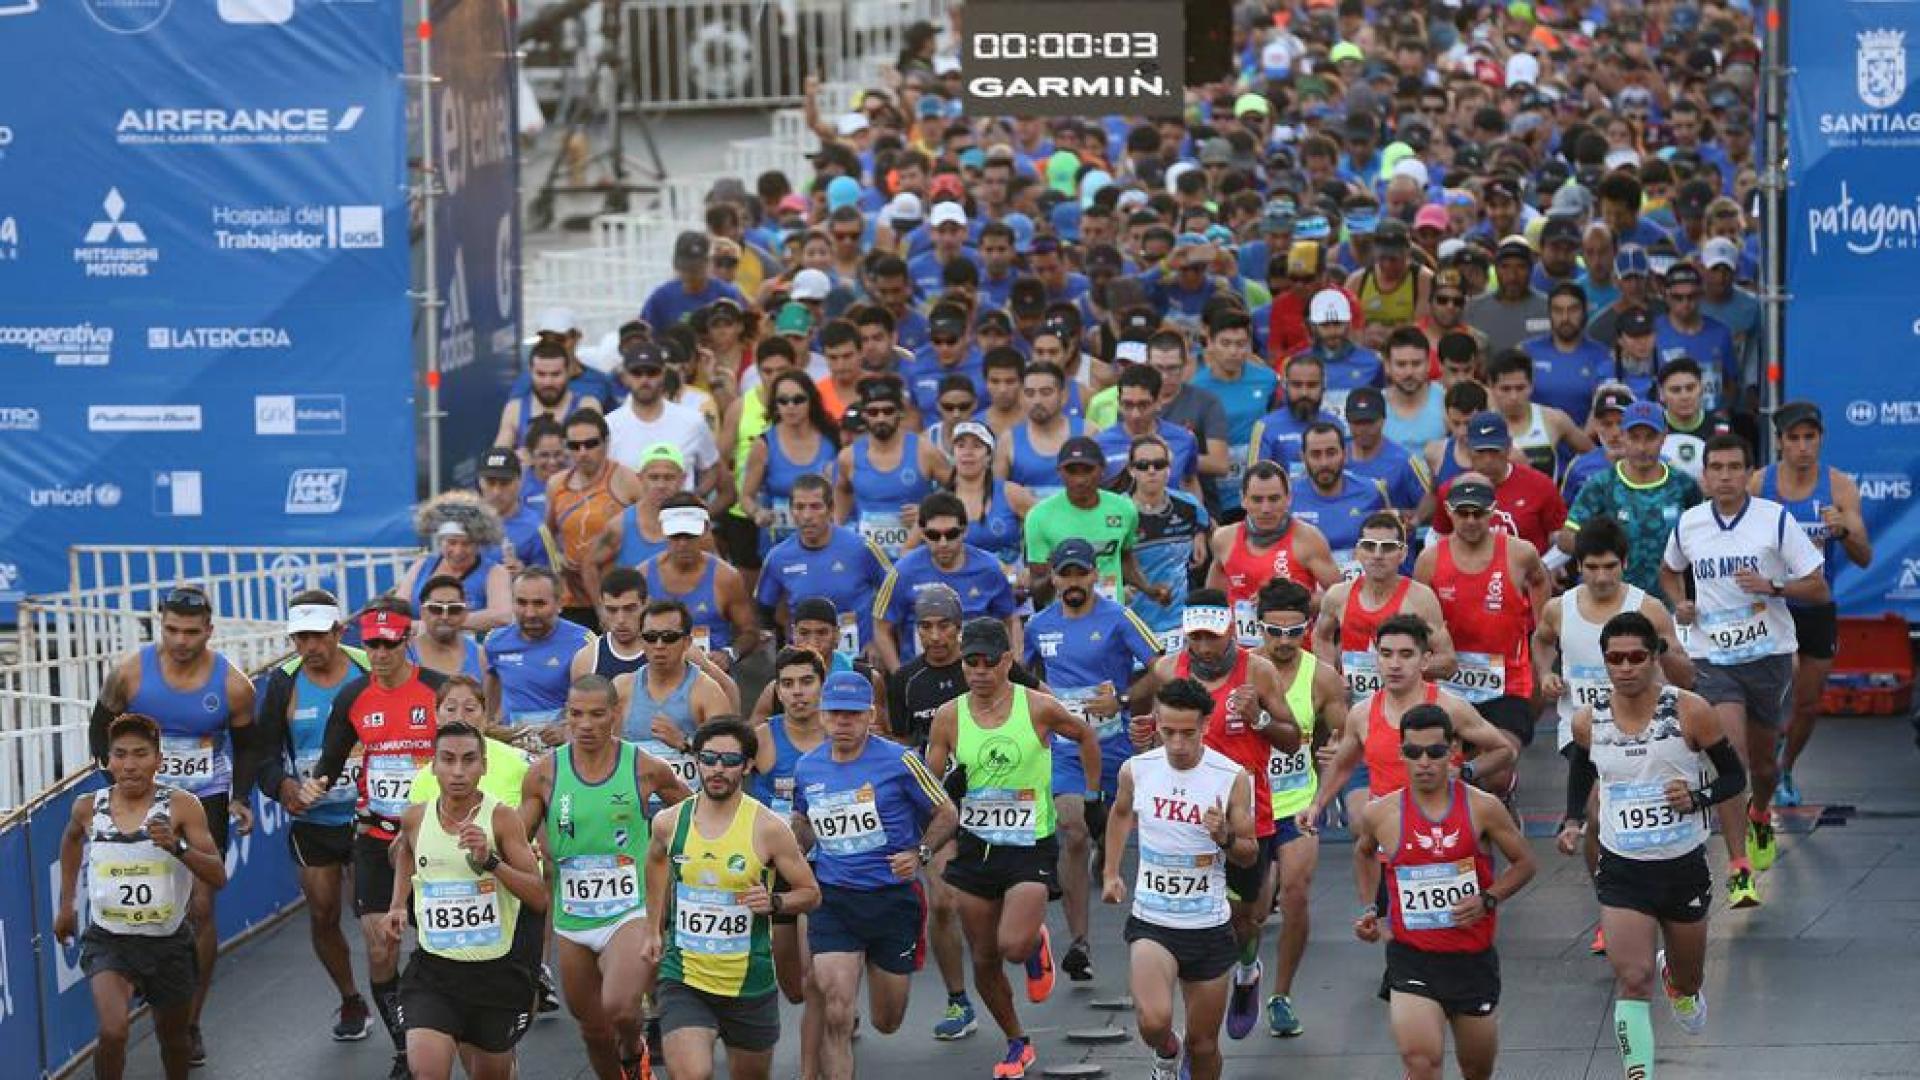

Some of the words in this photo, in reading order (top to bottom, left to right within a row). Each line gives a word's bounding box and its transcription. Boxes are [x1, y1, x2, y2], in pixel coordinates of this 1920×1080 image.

[973, 33, 1159, 59] 00:00:03
[968, 72, 1163, 97] GARMIN
[117, 109, 328, 131] AIRFRANCE
[213, 206, 290, 227] Hospital
[295, 205, 325, 224] del
[215, 230, 323, 251] Trabajador
[74, 247, 158, 262] MITSUBISHI
[86, 263, 148, 277] MOTORS
[31, 483, 92, 506] unicef
[1859, 480, 1911, 500] AIMS
[1695, 558, 1716, 580] LOS
[1709, 620, 1768, 649] 19244
[1347, 674, 1385, 692] 184
[963, 806, 1031, 828] 22107
[1153, 796, 1202, 824] YKA
[813, 812, 876, 837] 19716
[565, 876, 634, 900] 16716
[1143, 870, 1210, 896] 16574
[119, 884, 152, 907] 20
[1403, 882, 1475, 910] 21809
[426, 904, 496, 930] 18364
[680, 911, 747, 936] 16748
